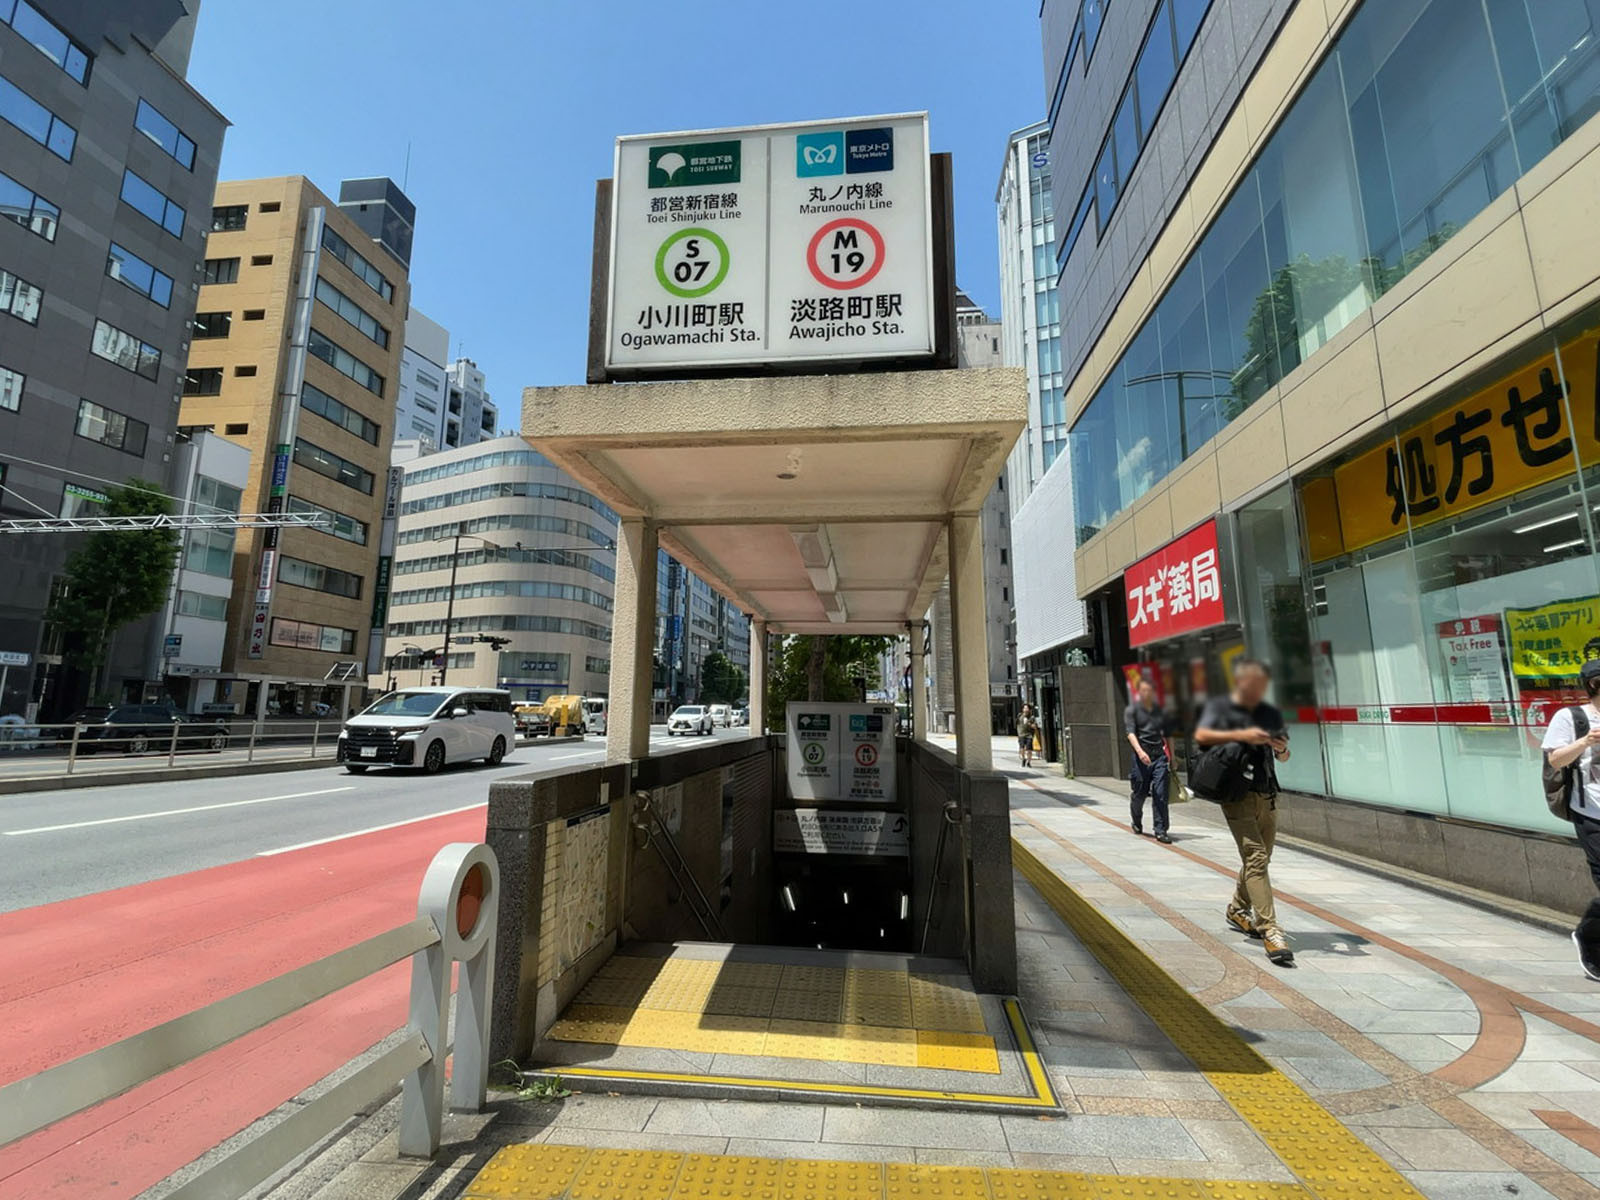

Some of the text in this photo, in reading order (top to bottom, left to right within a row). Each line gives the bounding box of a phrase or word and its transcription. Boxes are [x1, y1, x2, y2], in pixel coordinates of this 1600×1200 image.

[850, 142, 890, 153] 東京メトロ
[852, 150, 888, 160] Tokyo Metro
[690, 154, 733, 165] 都営地下鉄
[690, 163, 733, 173] TOEI SUBWAY
[809, 182, 884, 202] 丸ノ内線
[650, 193, 739, 214] 都営新宿線
[799, 198, 893, 215] Marunouchi Line
[646, 208, 742, 225] Toei Shinjuku Line
[685, 239, 700, 259] S
[833, 230, 858, 250] M
[674, 261, 710, 283] 07
[831, 252, 864, 274] 19
[638, 303, 744, 329] 小川町駅
[790, 294, 902, 322] 淡路町駅
[620, 327, 761, 350] Ogawamachi Sta.
[788, 320, 904, 342] Awajicho Sta.
[1386, 341, 1600, 525] 処方せ
[1129, 548, 1220, 629] スギ薬局
[1450, 638, 1492, 653] Tax Free
[808, 752, 819, 761] 07
[861, 753, 871, 762] 19
